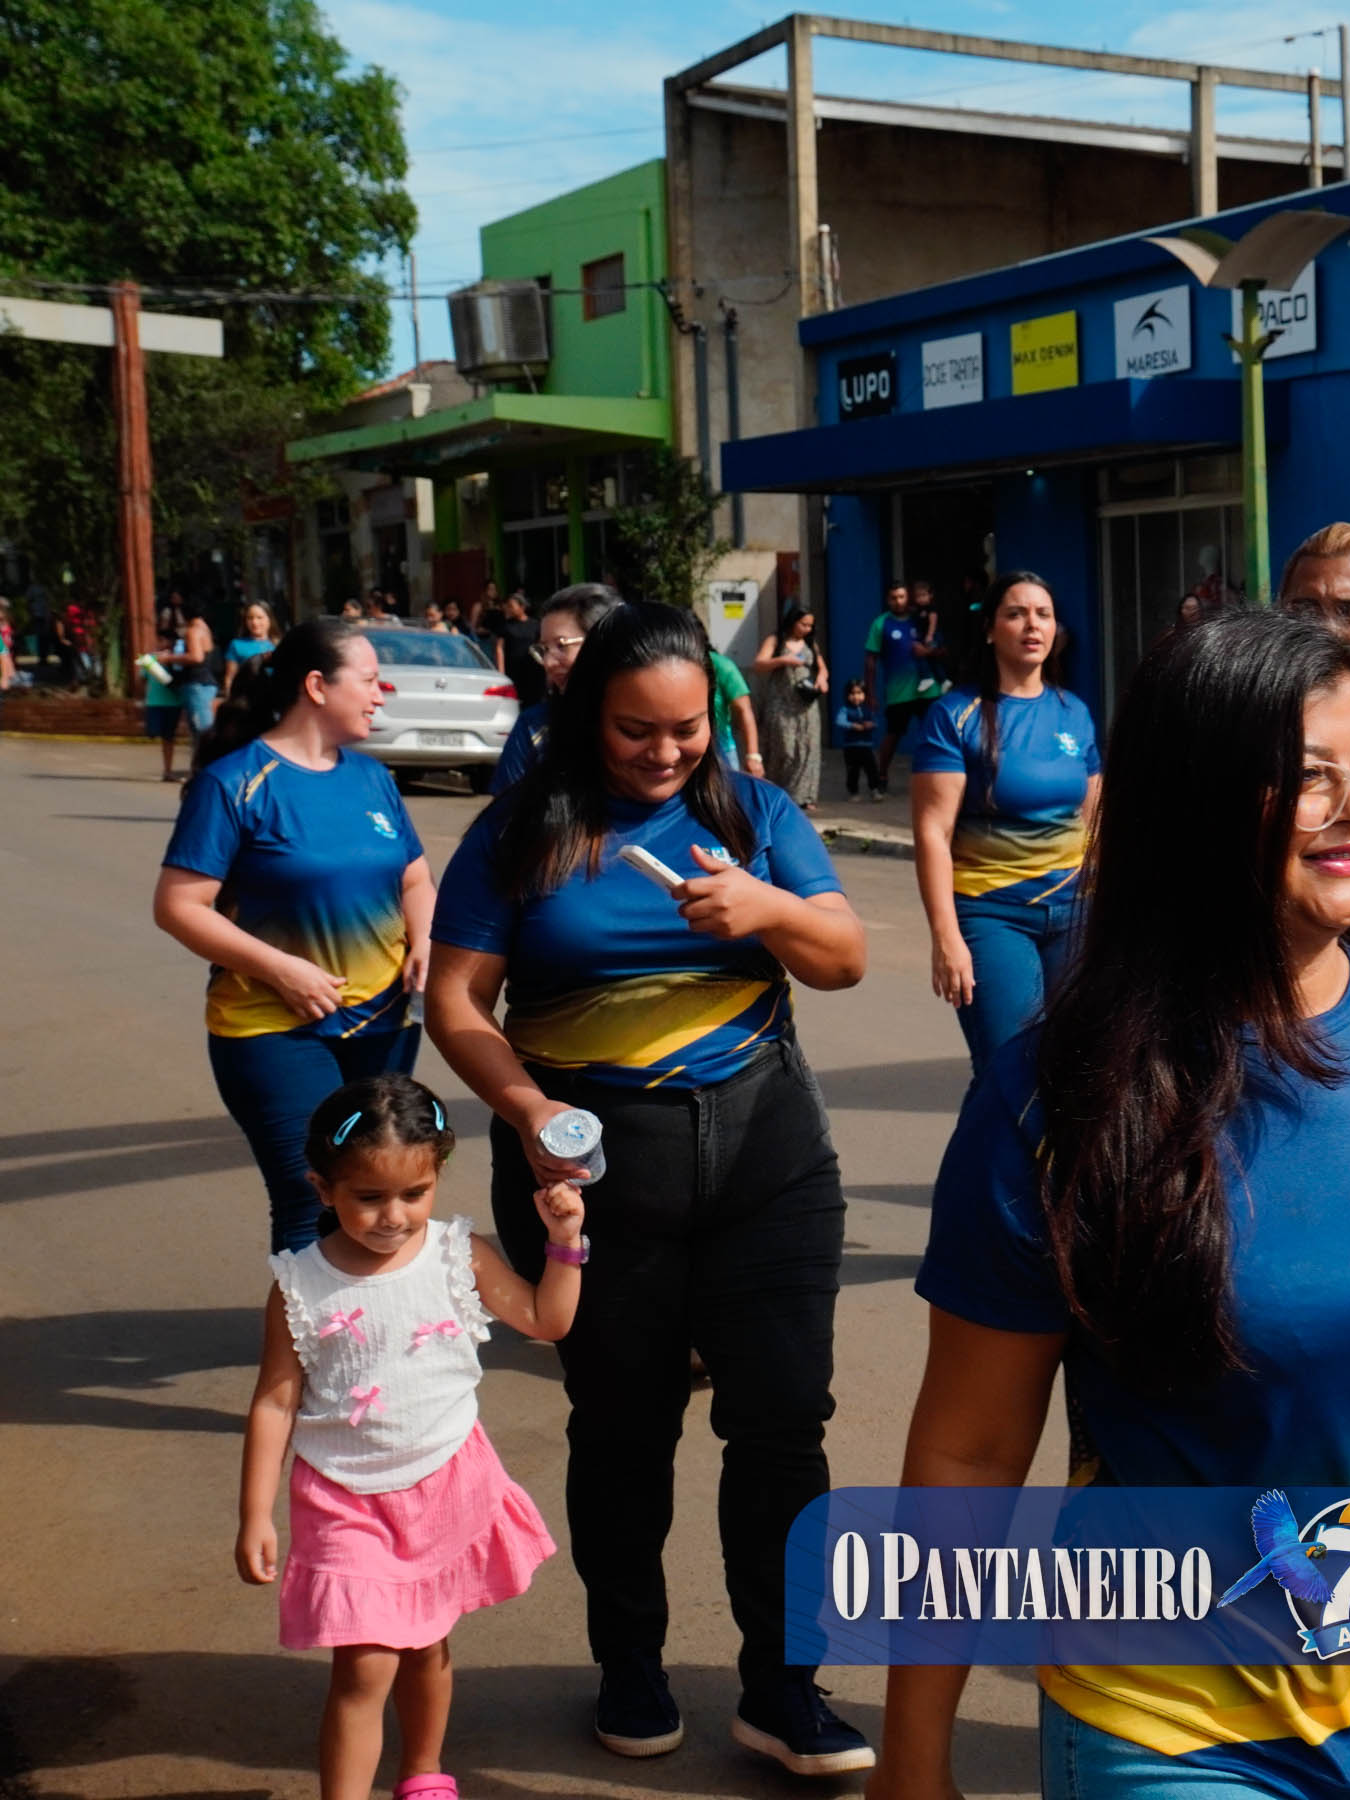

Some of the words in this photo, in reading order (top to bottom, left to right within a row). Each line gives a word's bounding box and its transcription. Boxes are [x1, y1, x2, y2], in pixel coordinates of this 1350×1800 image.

[1013, 349, 1037, 366] MAX
[1039, 343, 1075, 362] DENIM
[1126, 349, 1179, 373] MARESIA
[840, 370, 891, 412] LUPO
